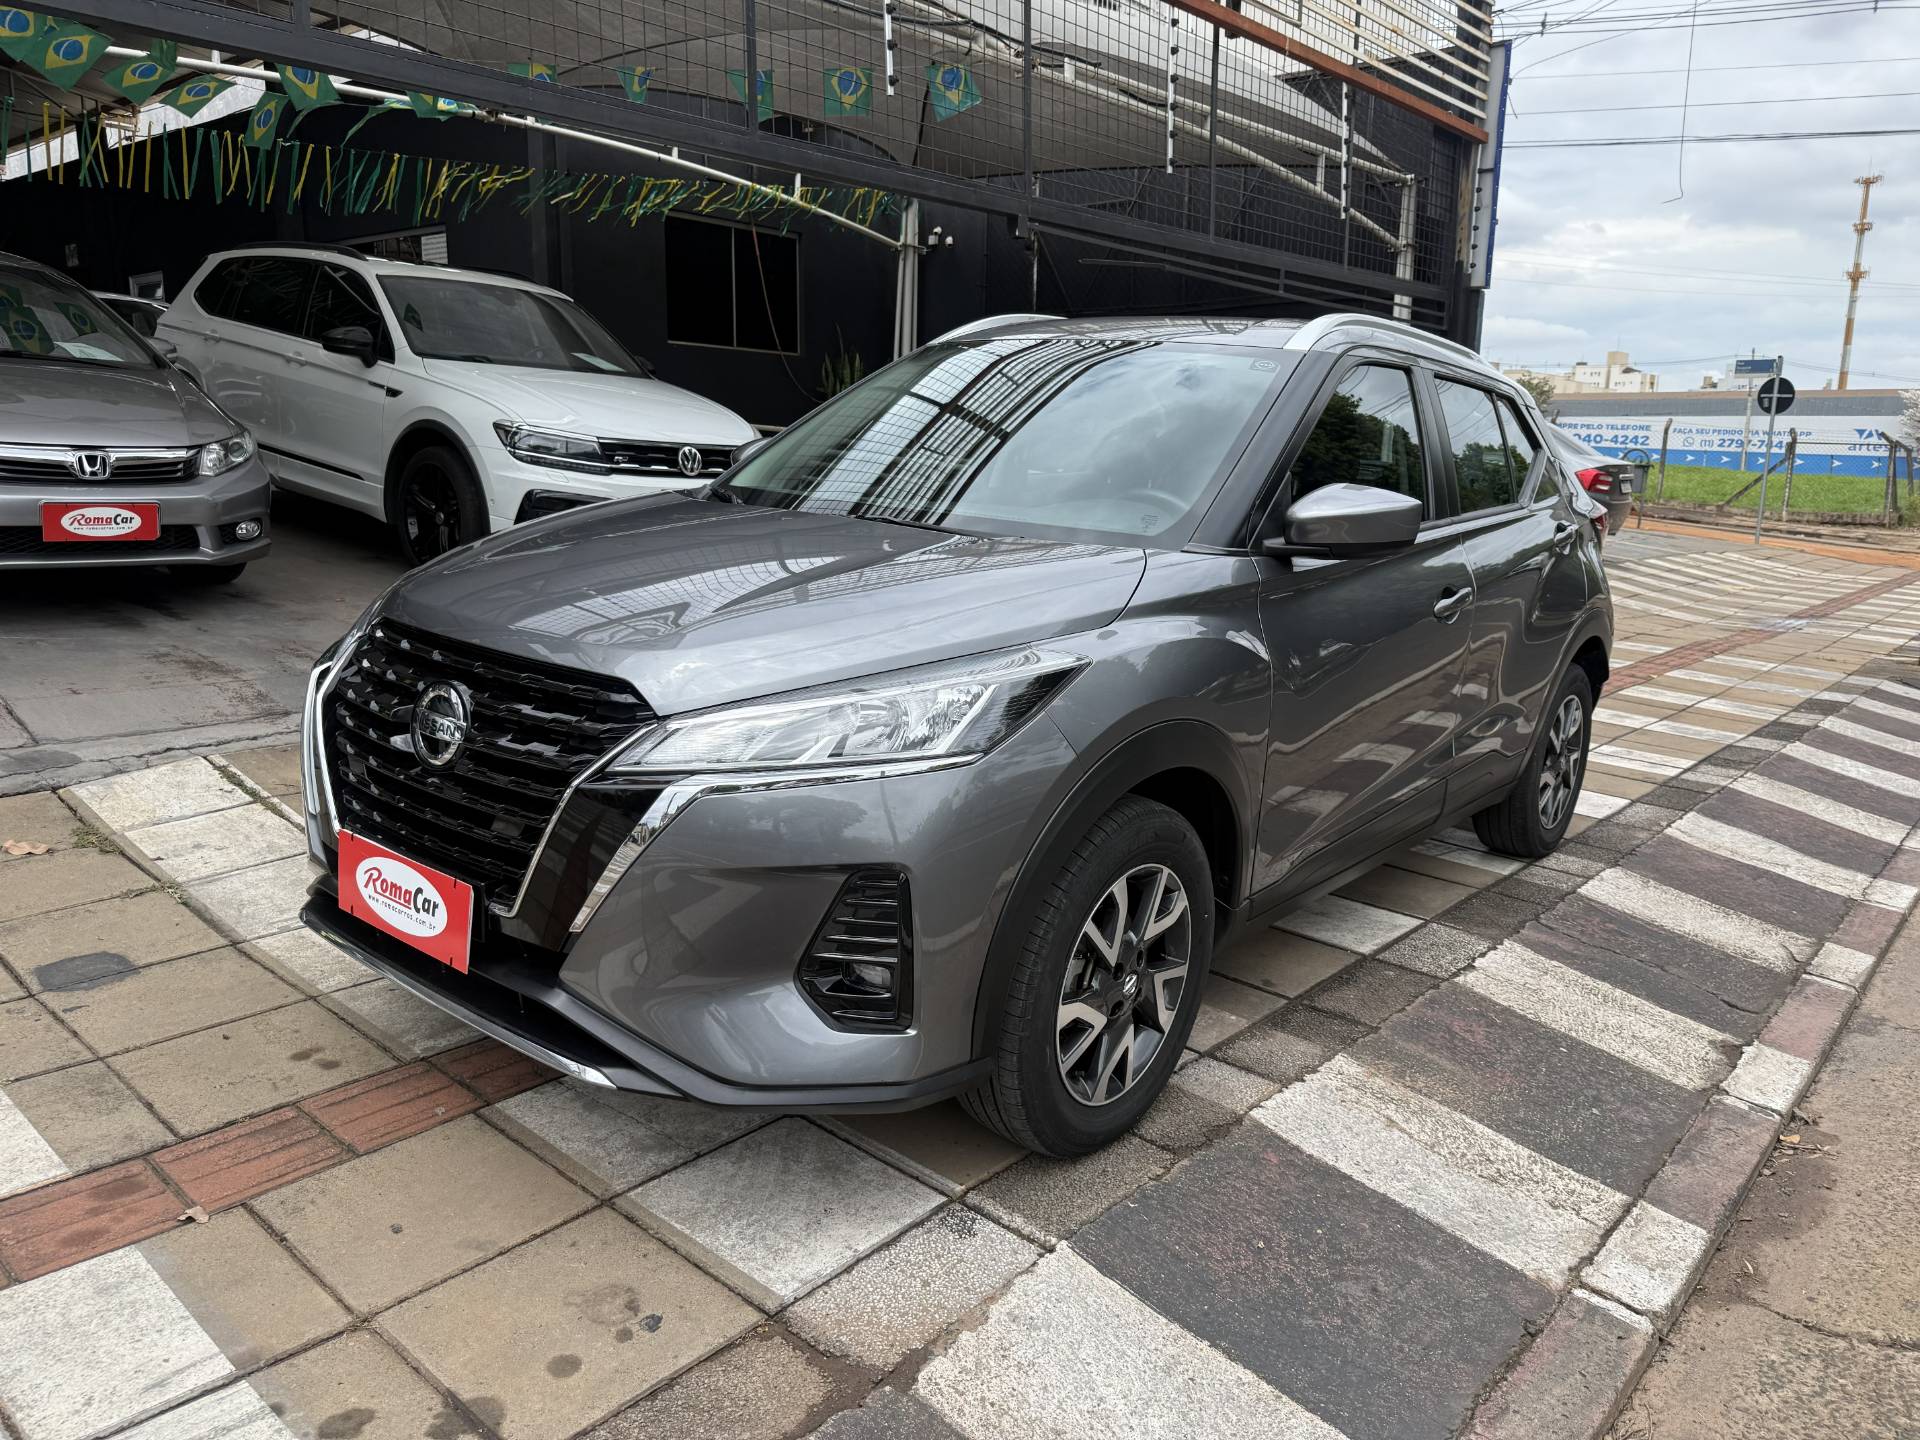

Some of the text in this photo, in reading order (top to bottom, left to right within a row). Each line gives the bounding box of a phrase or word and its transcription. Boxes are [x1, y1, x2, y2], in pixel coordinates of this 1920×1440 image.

[1580, 422, 1604, 430] PELO
[1606, 423, 1651, 432] TELEFONE
[1672, 427, 1694, 435] FAÇA
[1695, 427, 1711, 435] SEU
[1711, 428, 1744, 436] PEDIDO
[1700, 438, 1714, 447] (11)
[68, 513, 135, 526] RomaCar
[363, 866, 440, 917] RomaCar
